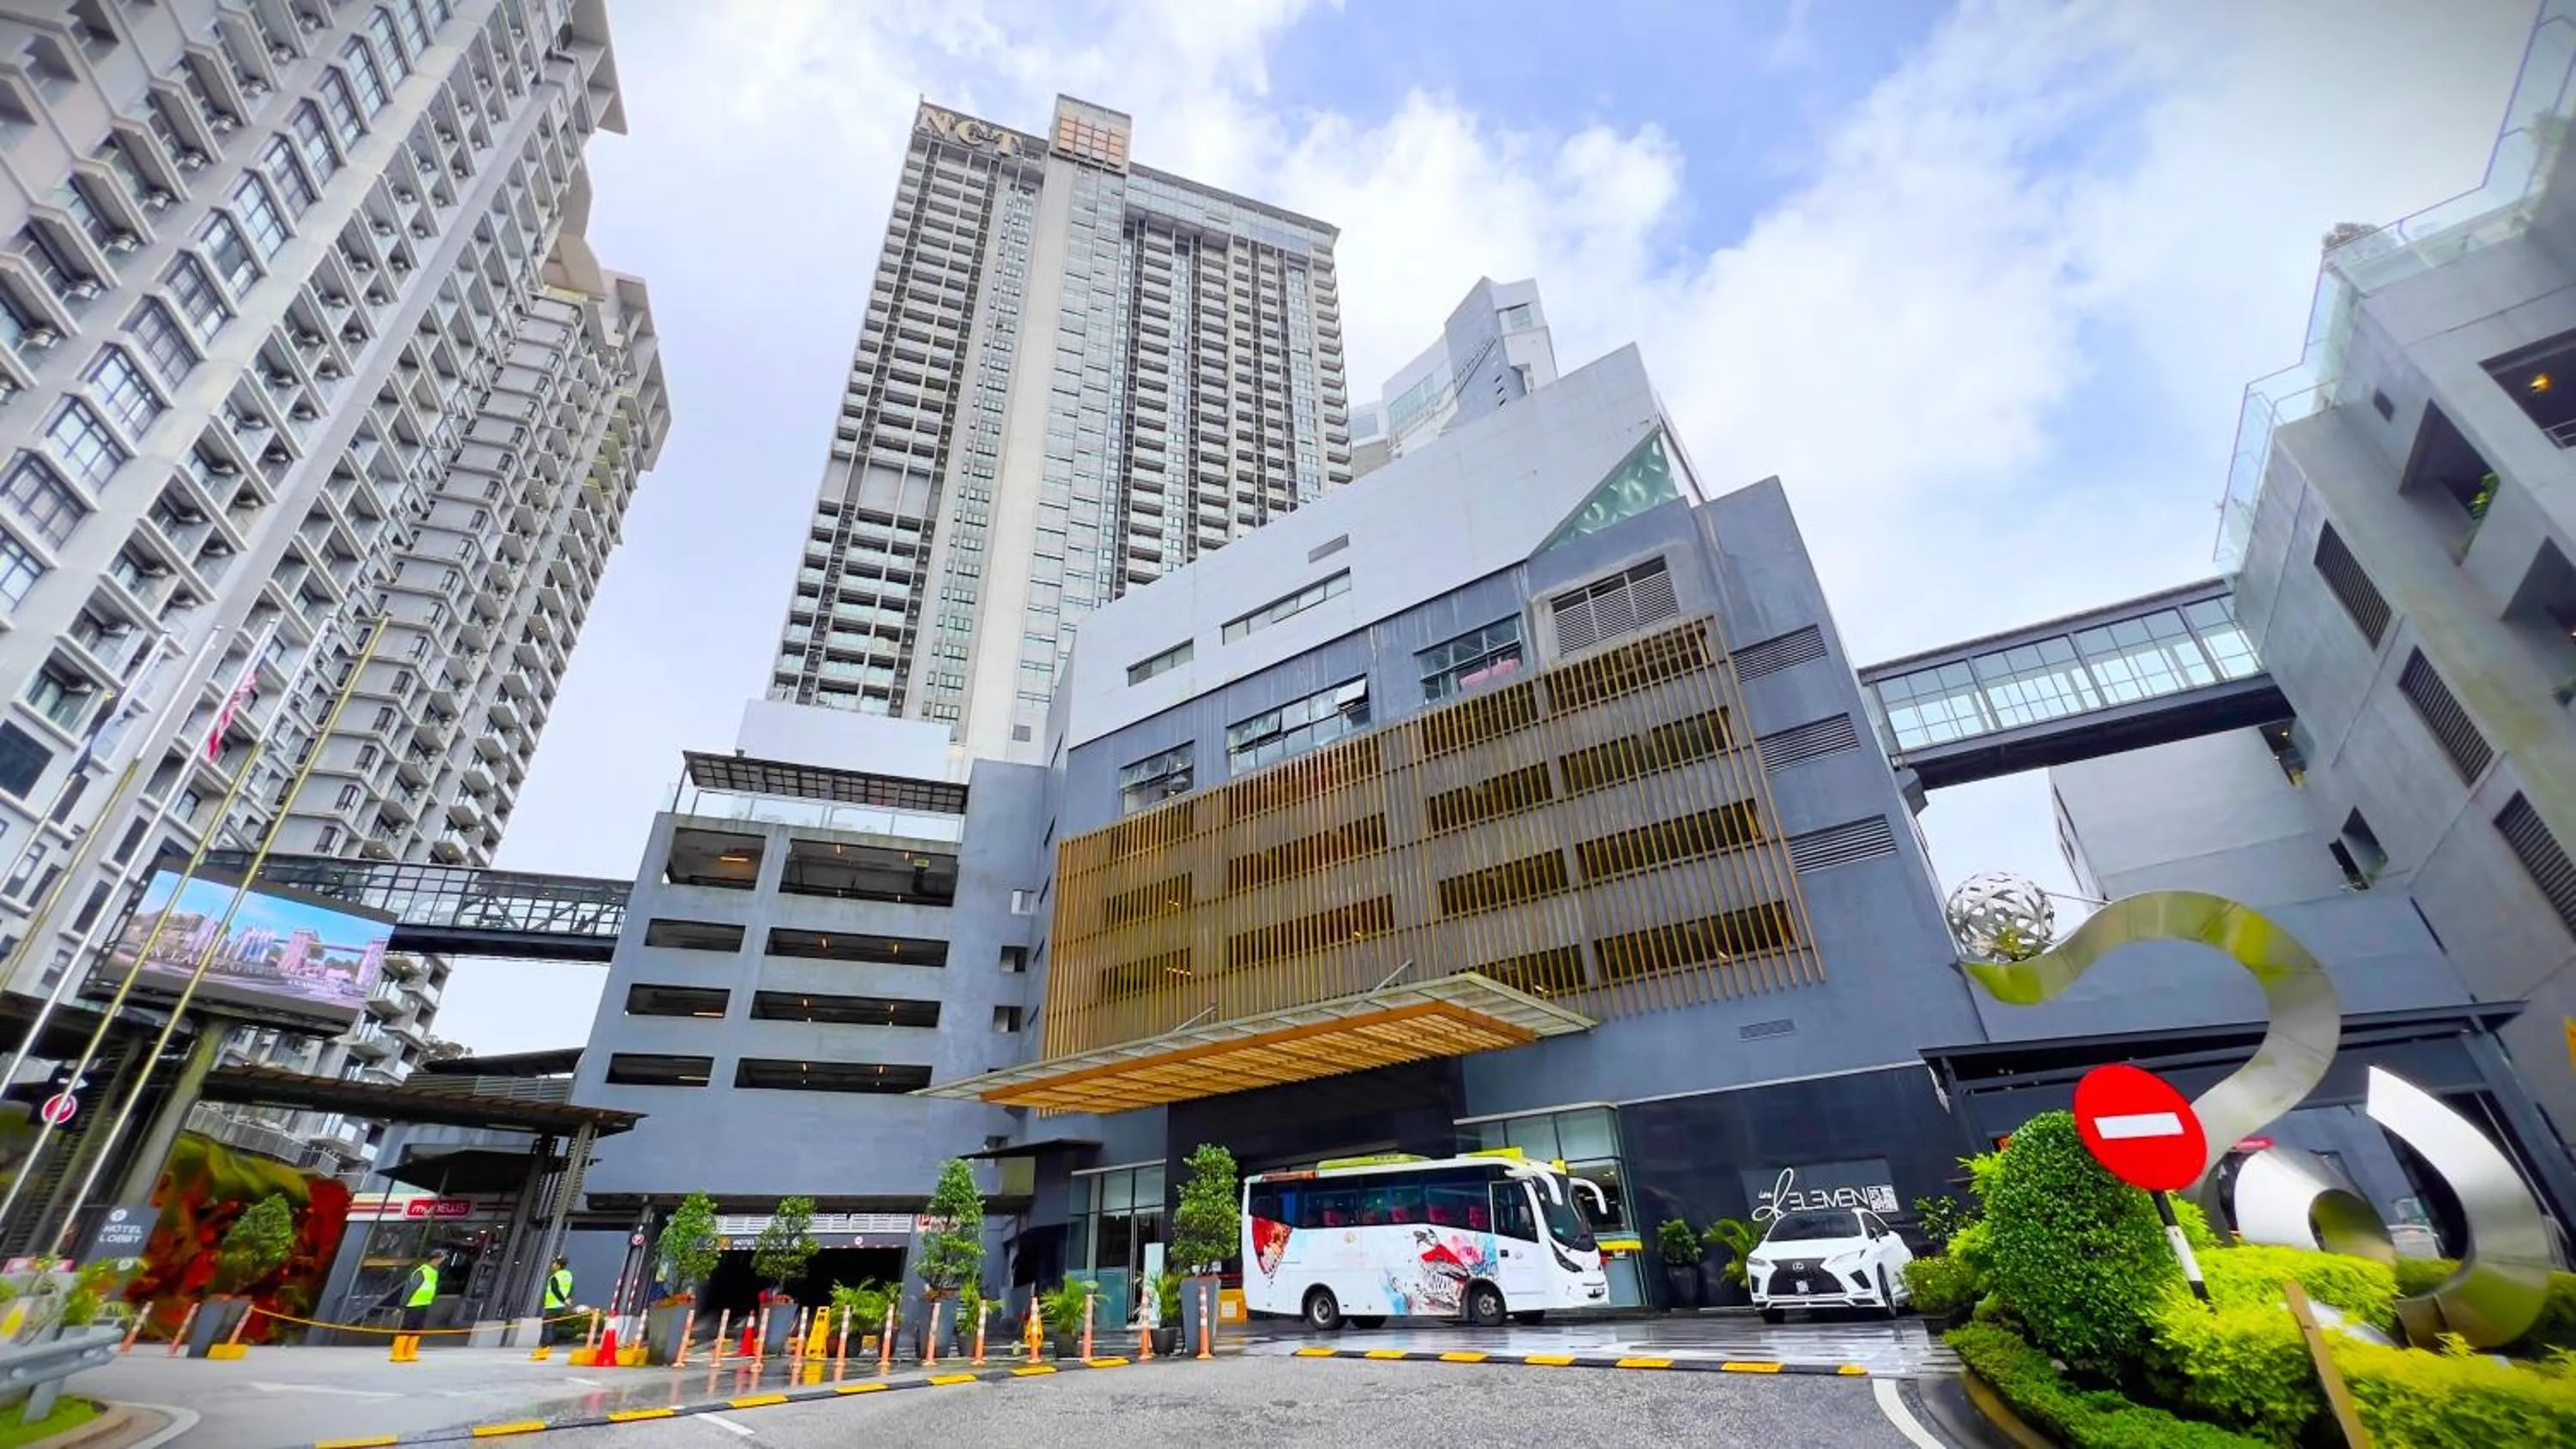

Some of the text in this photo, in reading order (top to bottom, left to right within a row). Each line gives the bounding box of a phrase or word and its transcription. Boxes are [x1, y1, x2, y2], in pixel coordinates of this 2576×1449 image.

[916, 106, 1023, 155] NCT
[103, 1225, 141, 1234] HOTEL
[99, 1234, 141, 1243] LOBBY
